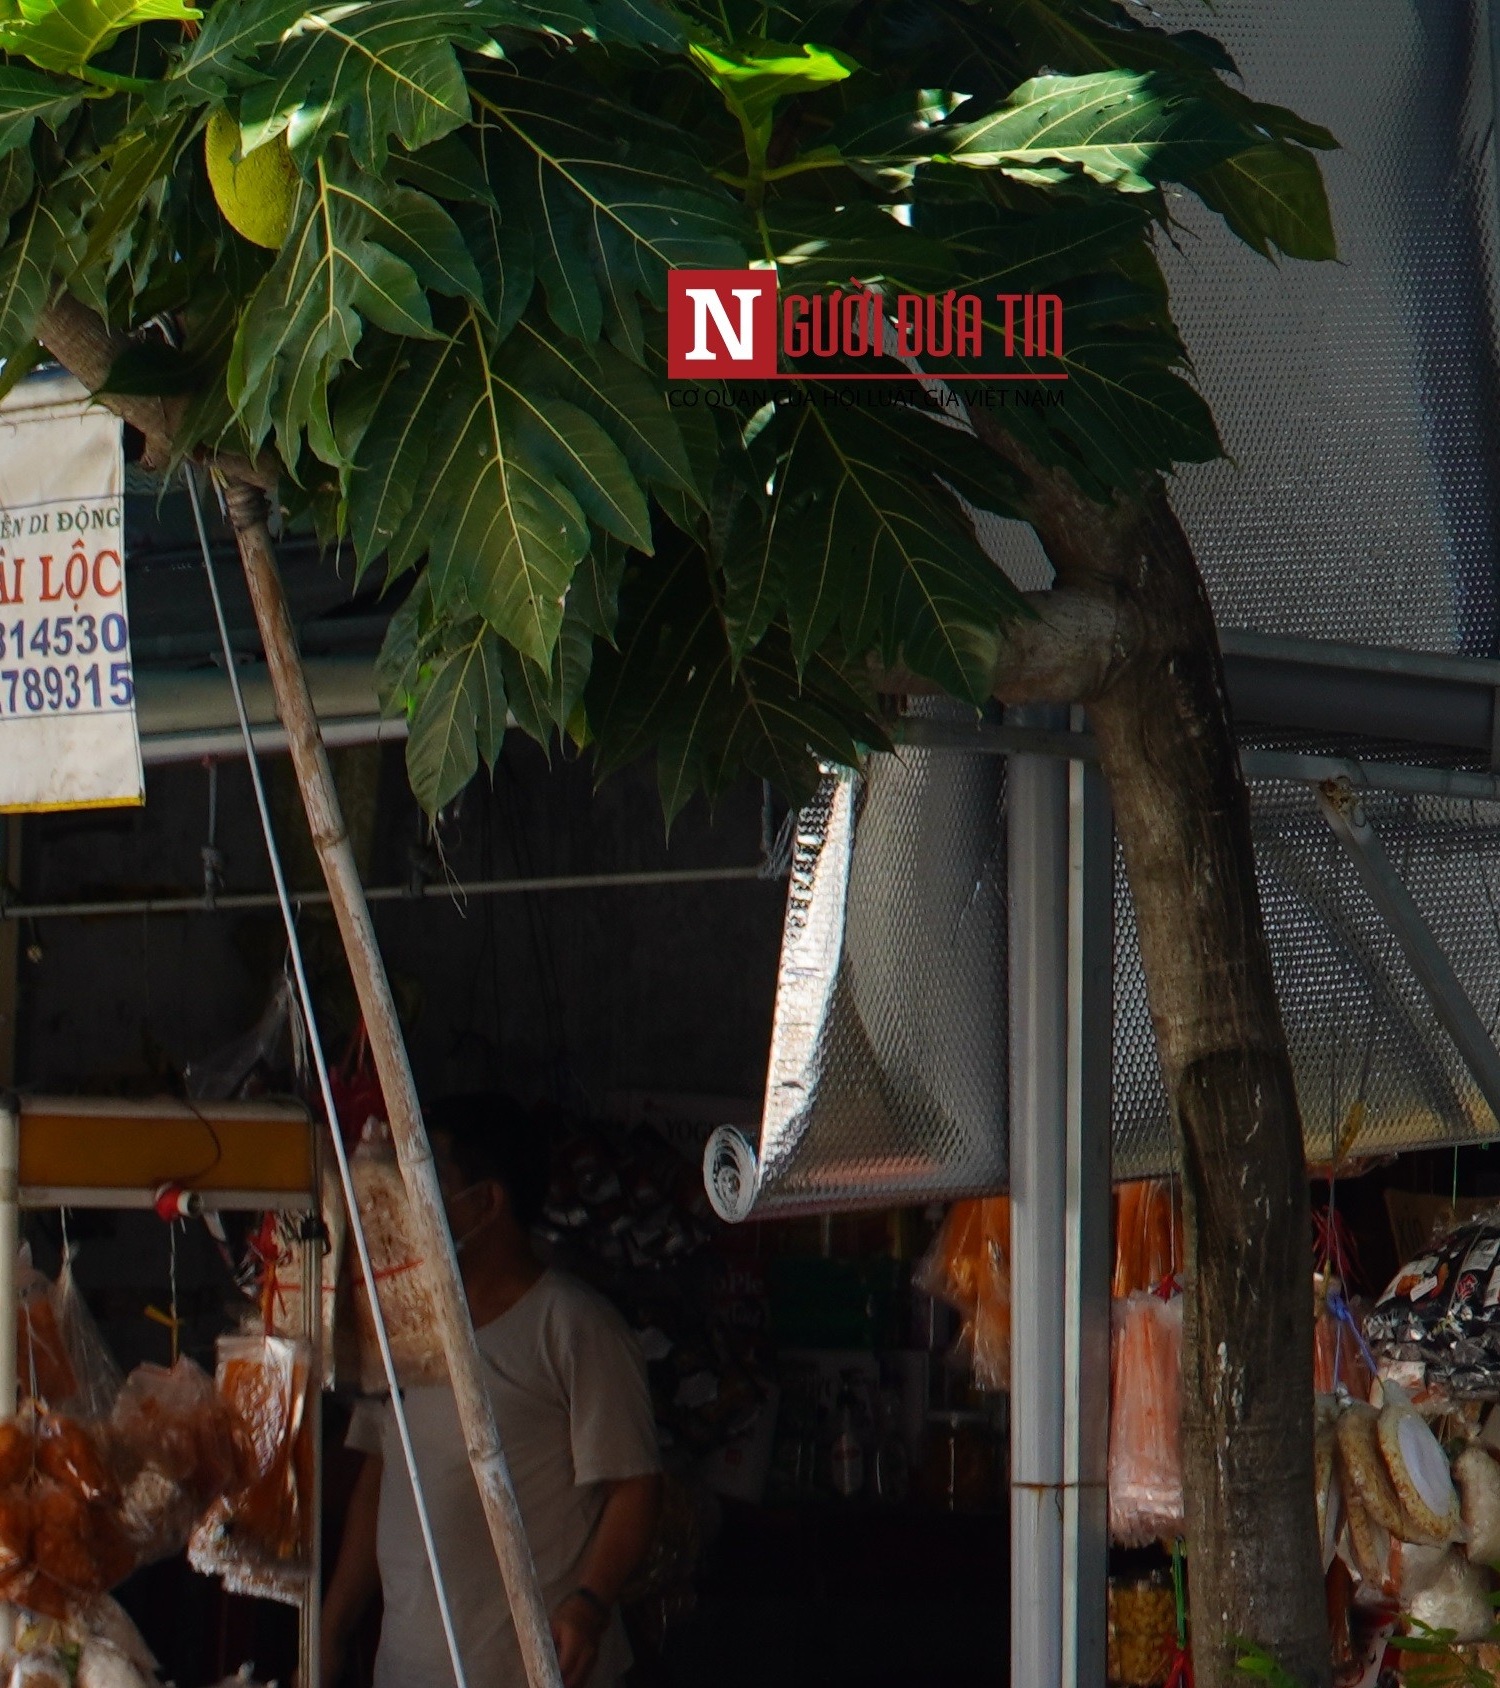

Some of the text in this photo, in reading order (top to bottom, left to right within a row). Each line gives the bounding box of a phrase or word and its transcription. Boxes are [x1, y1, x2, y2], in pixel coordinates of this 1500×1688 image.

[28, 513, 49, 536] DI
[57, 504, 121, 536] ĐỘNG
[39, 538, 123, 612] LỘC
